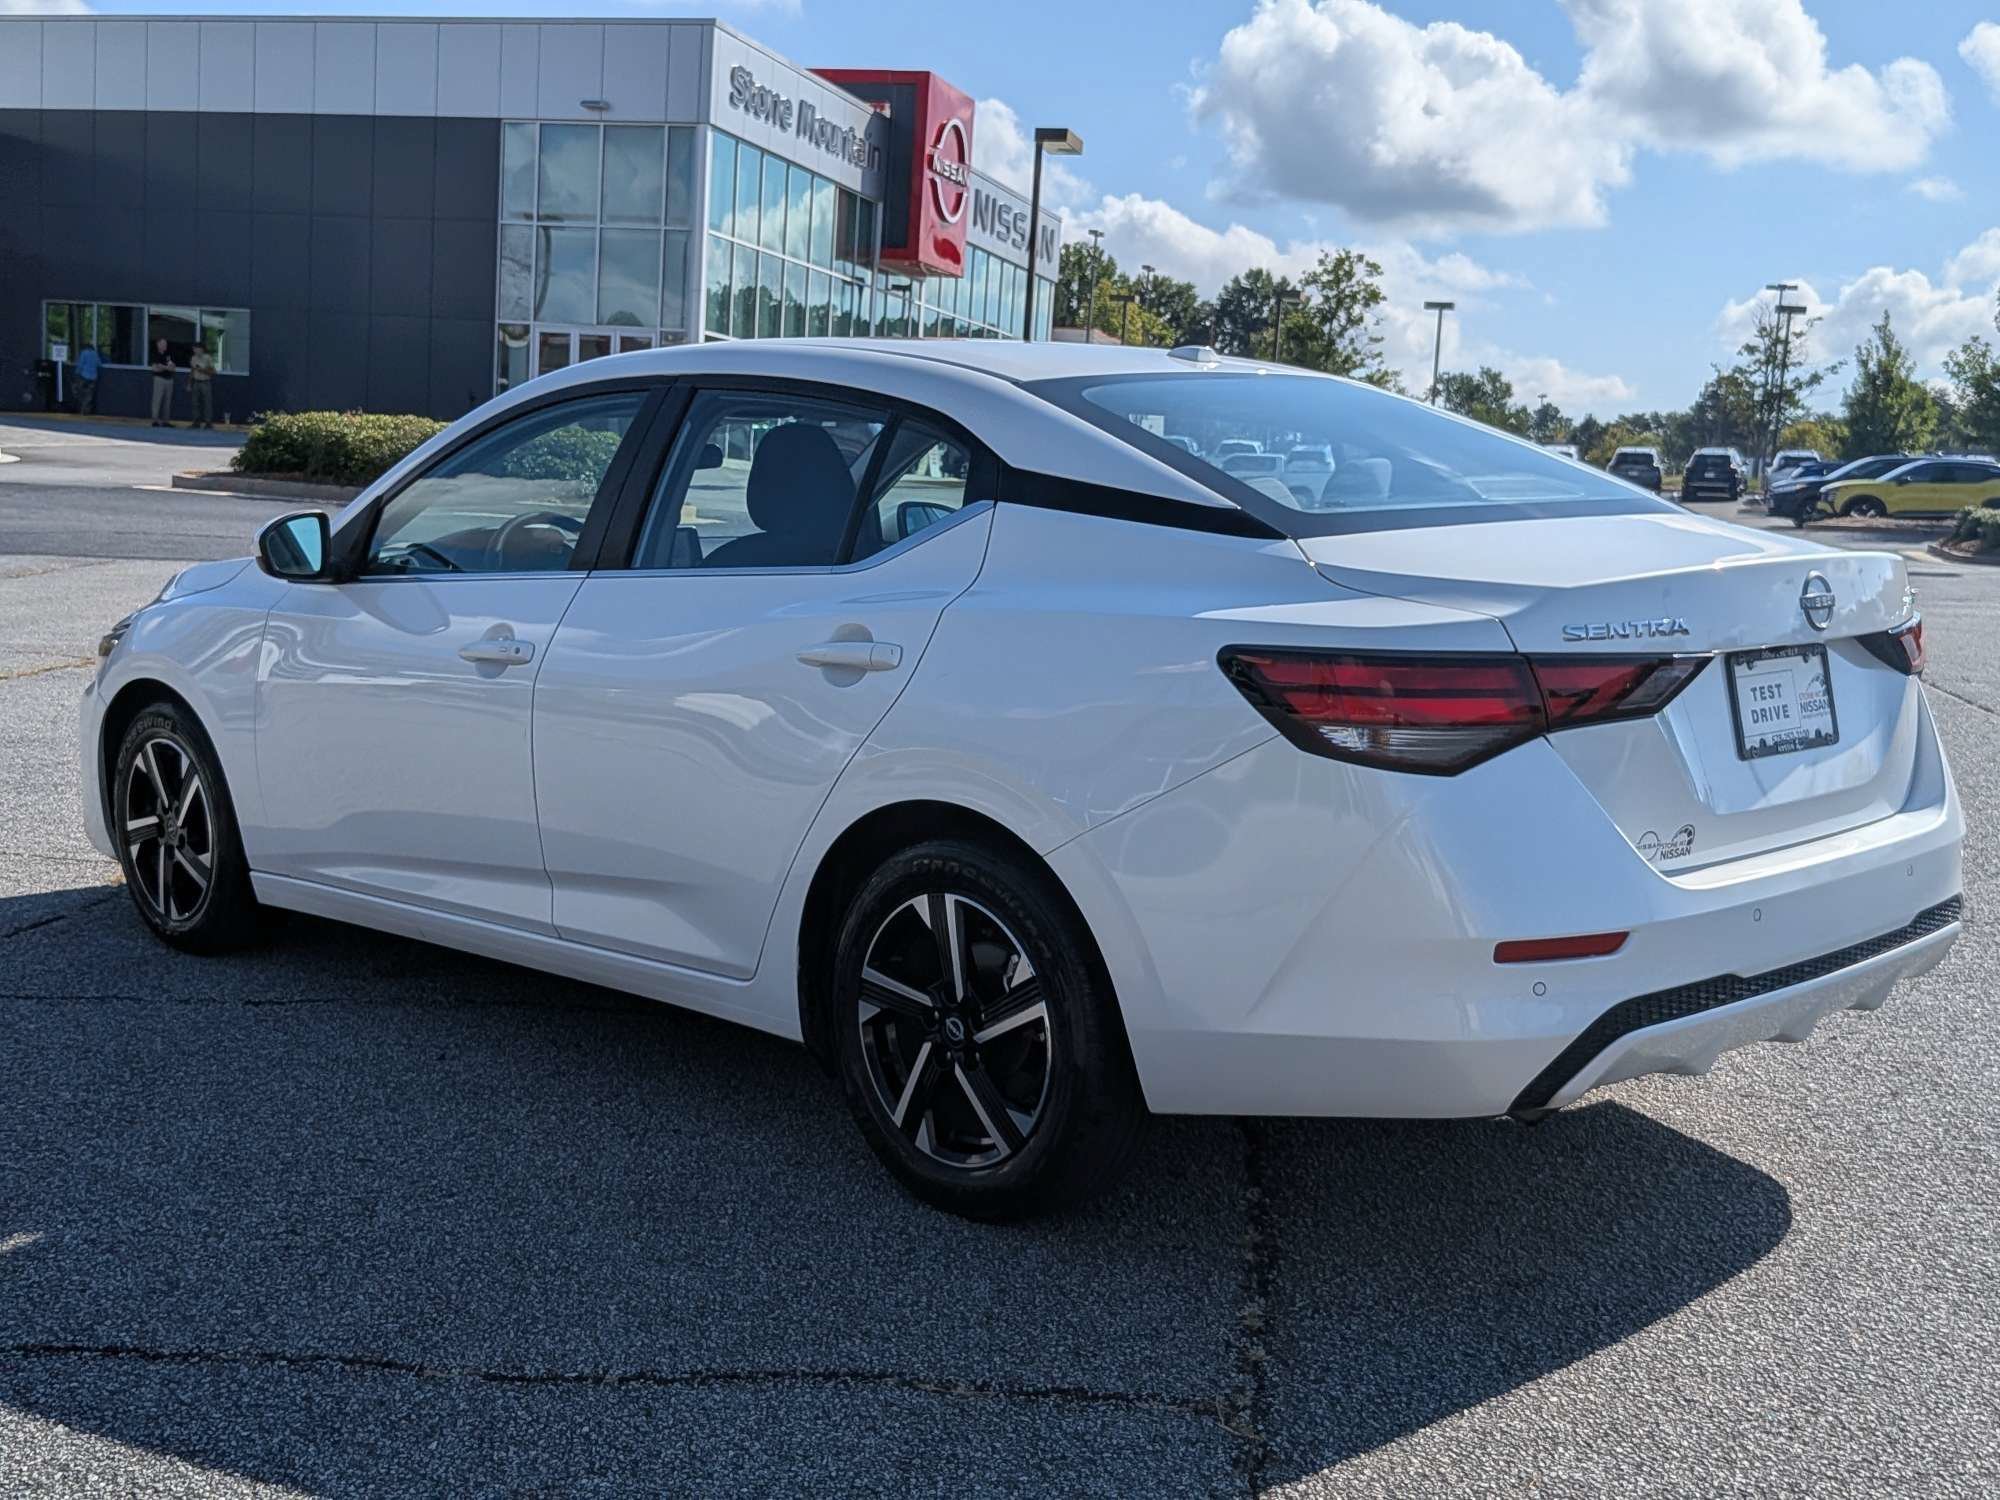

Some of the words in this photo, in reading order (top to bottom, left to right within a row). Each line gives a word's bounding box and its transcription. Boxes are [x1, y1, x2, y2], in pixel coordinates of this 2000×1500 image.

[729, 64, 792, 132] Stone
[796, 99, 881, 170] Mountain
[1562, 617, 1691, 642] SENTRA
[1750, 683, 1782, 702] TEST
[1751, 704, 1790, 724] DRIVE
[1660, 846, 1692, 860] NISSAN
